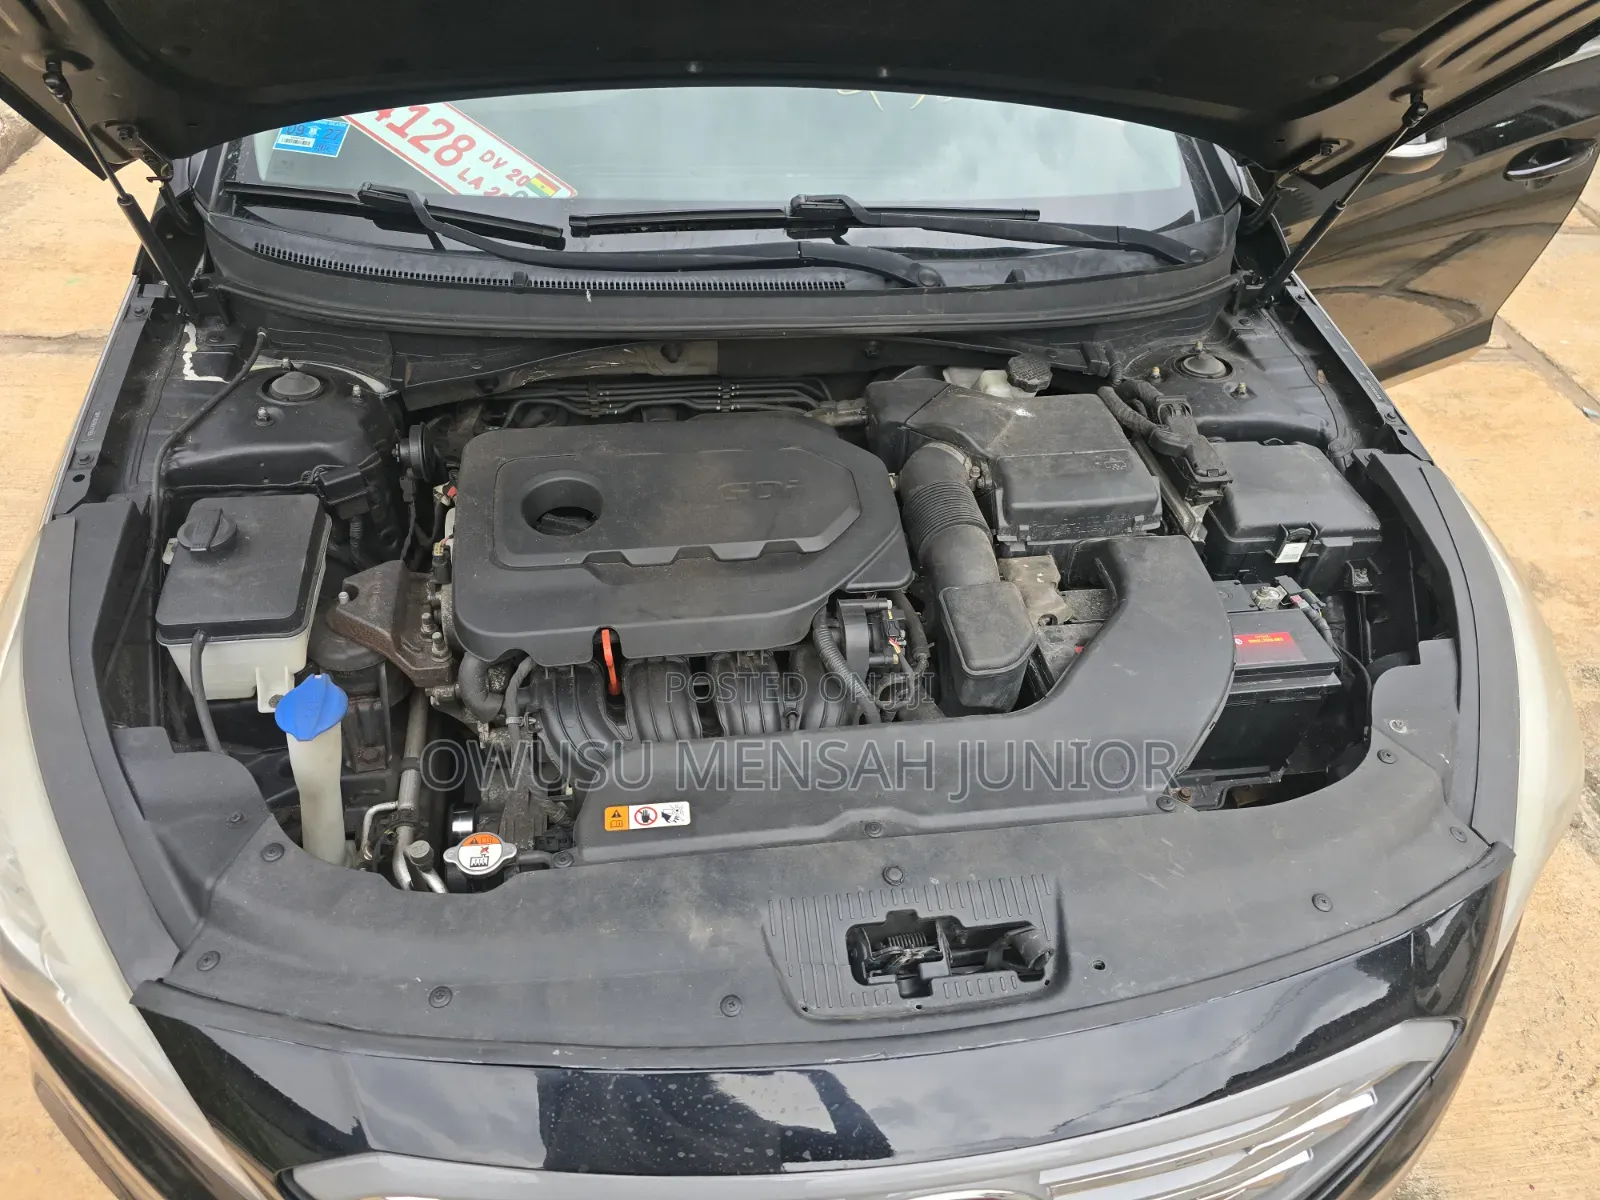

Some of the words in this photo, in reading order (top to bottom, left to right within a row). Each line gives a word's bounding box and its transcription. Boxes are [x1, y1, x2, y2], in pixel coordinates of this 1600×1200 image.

[323, 128, 343, 141] 27
[457, 167, 484, 190] LA
[479, 149, 508, 169] DV
[505, 168, 530, 187] 20
